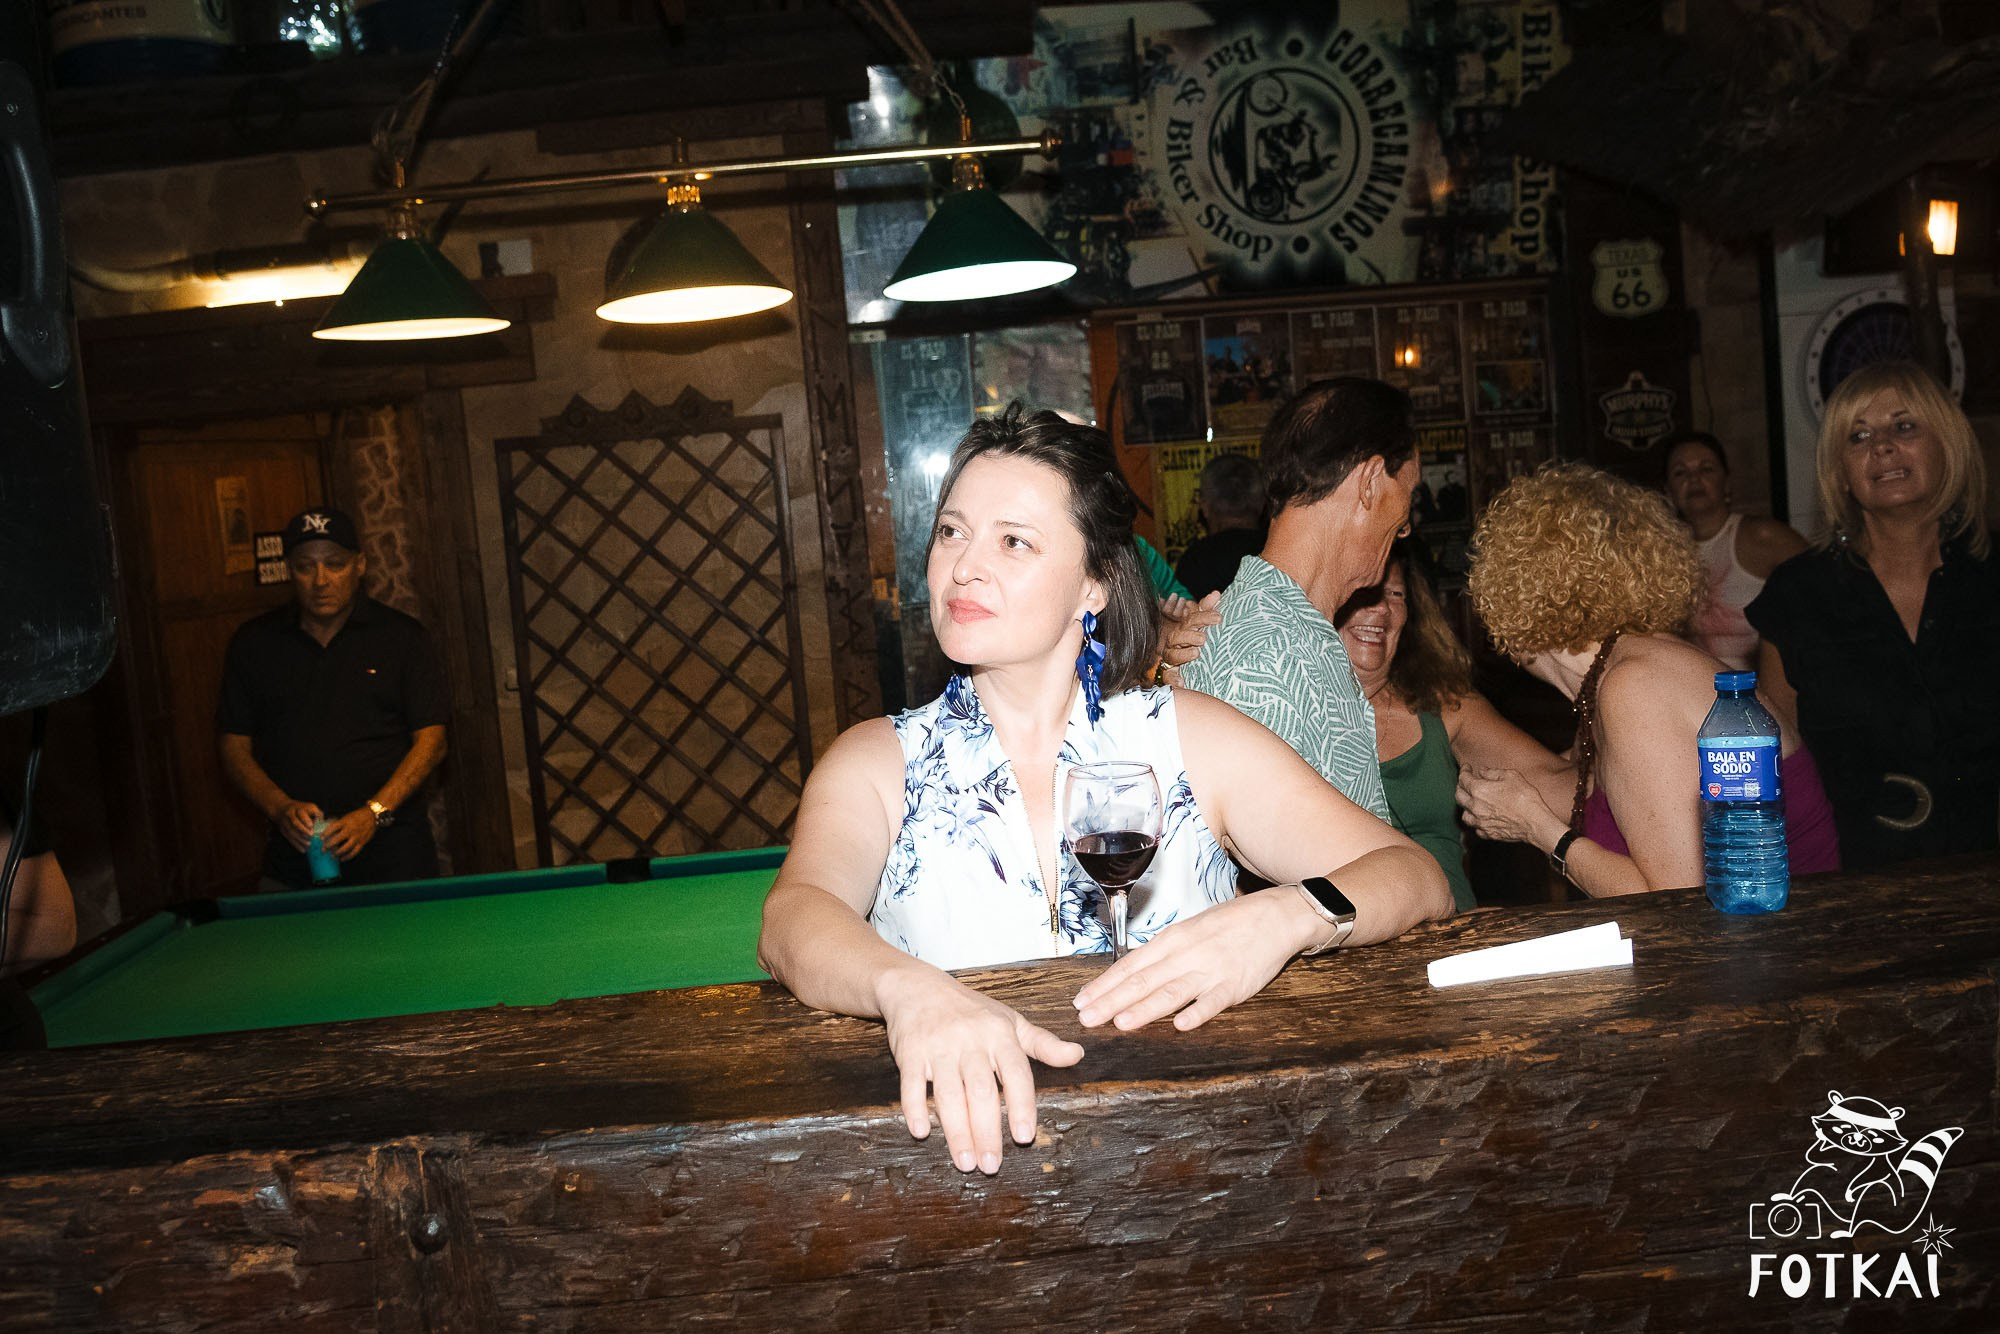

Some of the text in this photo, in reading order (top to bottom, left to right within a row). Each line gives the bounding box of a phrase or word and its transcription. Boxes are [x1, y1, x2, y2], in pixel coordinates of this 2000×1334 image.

[1165, 34, 1274, 261] Bar & Biker Shop
[1612, 280, 1651, 309] 66
[302, 513, 332, 534] NY
[1708, 751, 1756, 763] BAJA EN
[1712, 763, 1752, 774] SODIO
